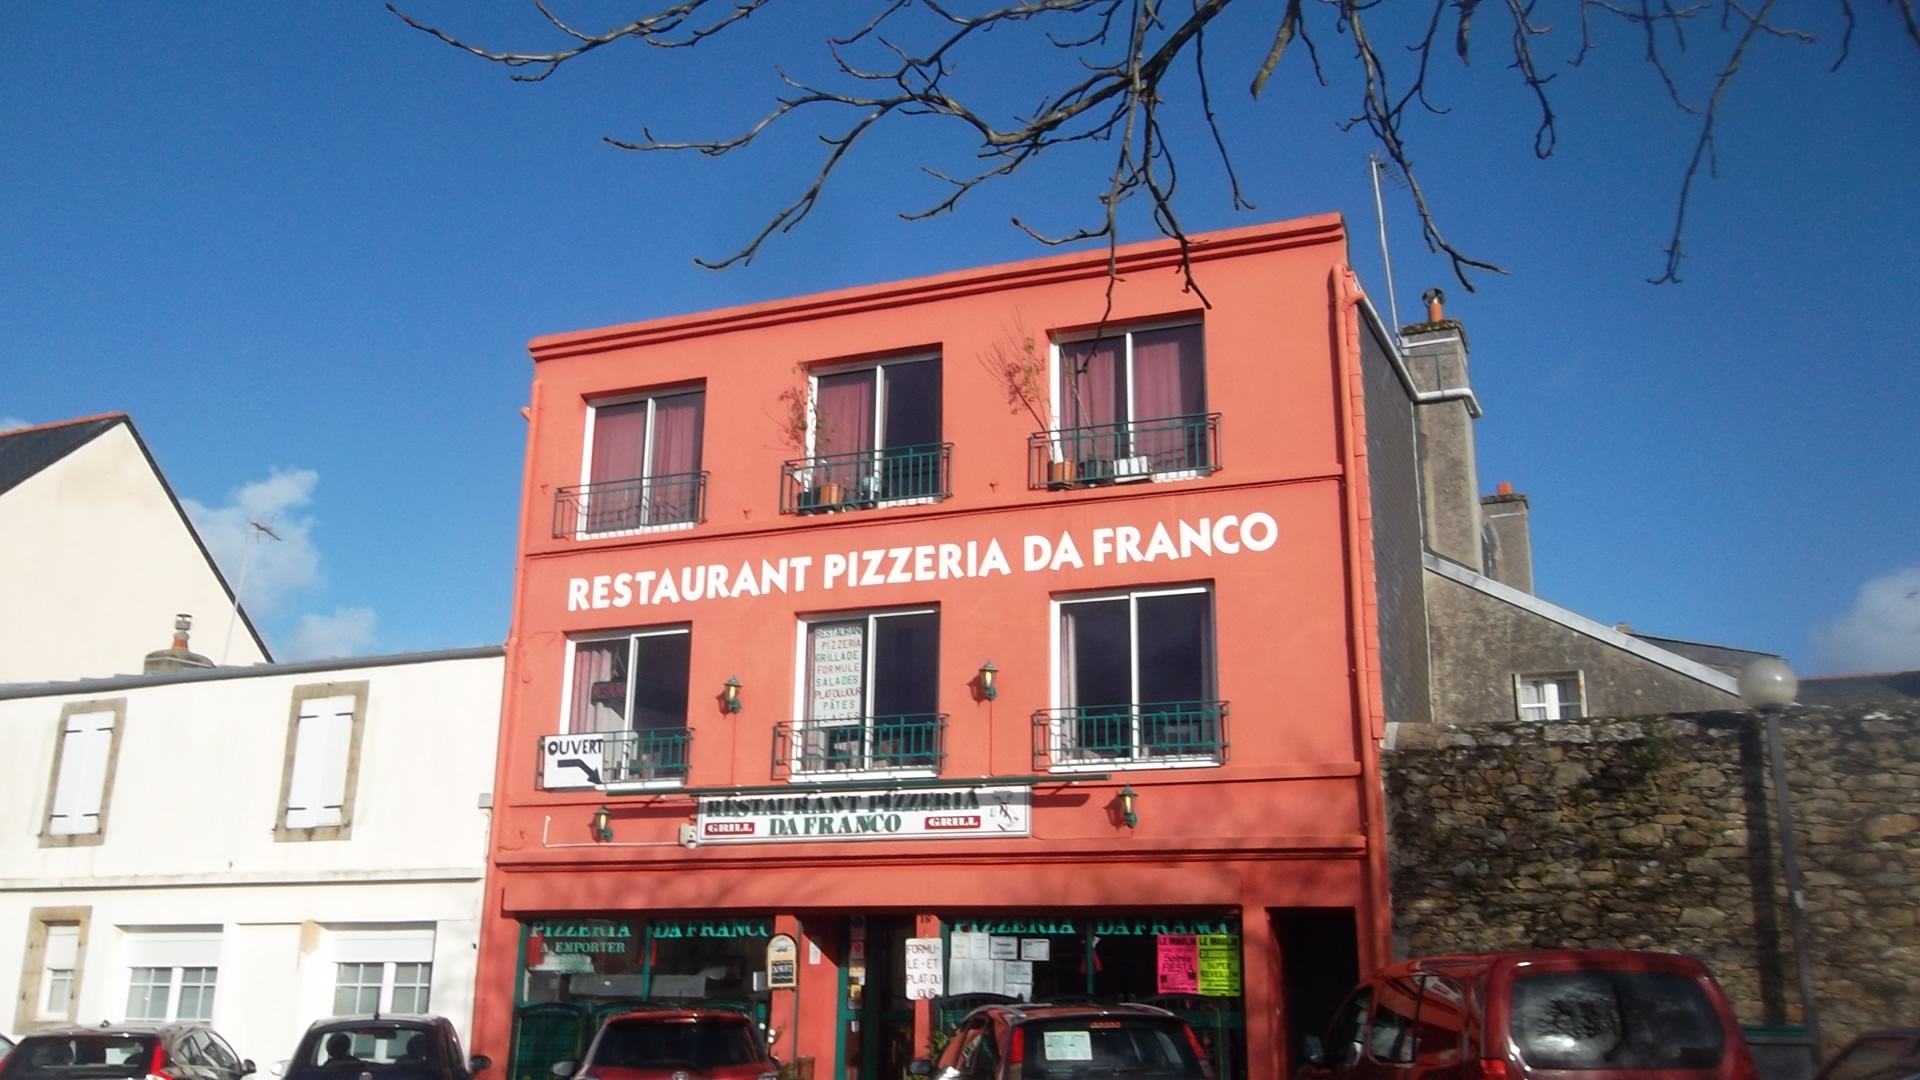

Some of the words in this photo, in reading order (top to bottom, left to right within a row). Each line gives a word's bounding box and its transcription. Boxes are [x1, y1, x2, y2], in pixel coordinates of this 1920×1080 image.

[567, 556, 812, 612] RESTAURANT
[823, 537, 1012, 590] PIZZERIA
[1023, 530, 1085, 572] DA
[1093, 512, 1278, 566] FRANCO
[821, 639, 861, 650] PIZZERIA
[815, 650, 859, 662] GRILLADE
[817, 662, 860, 674] FORMULE
[815, 675, 859, 687] SALADES
[823, 698, 856, 710] PÂTES
[547, 739, 603, 756] OUVERT
[707, 795, 862, 817] RESTAURANT
[868, 789, 979, 812] PIZZERIA
[707, 822, 753, 833] GRILL
[769, 817, 798, 836] DA
[803, 813, 902, 835] FRANCO
[928, 816, 979, 827] GRILL
[529, 922, 632, 938] PIZZERIA
[653, 922, 683, 938] DA
[953, 920, 1077, 935] PIZZERIA
[1096, 918, 1131, 935] DA
[554, 941, 626, 953] EMPORTER
